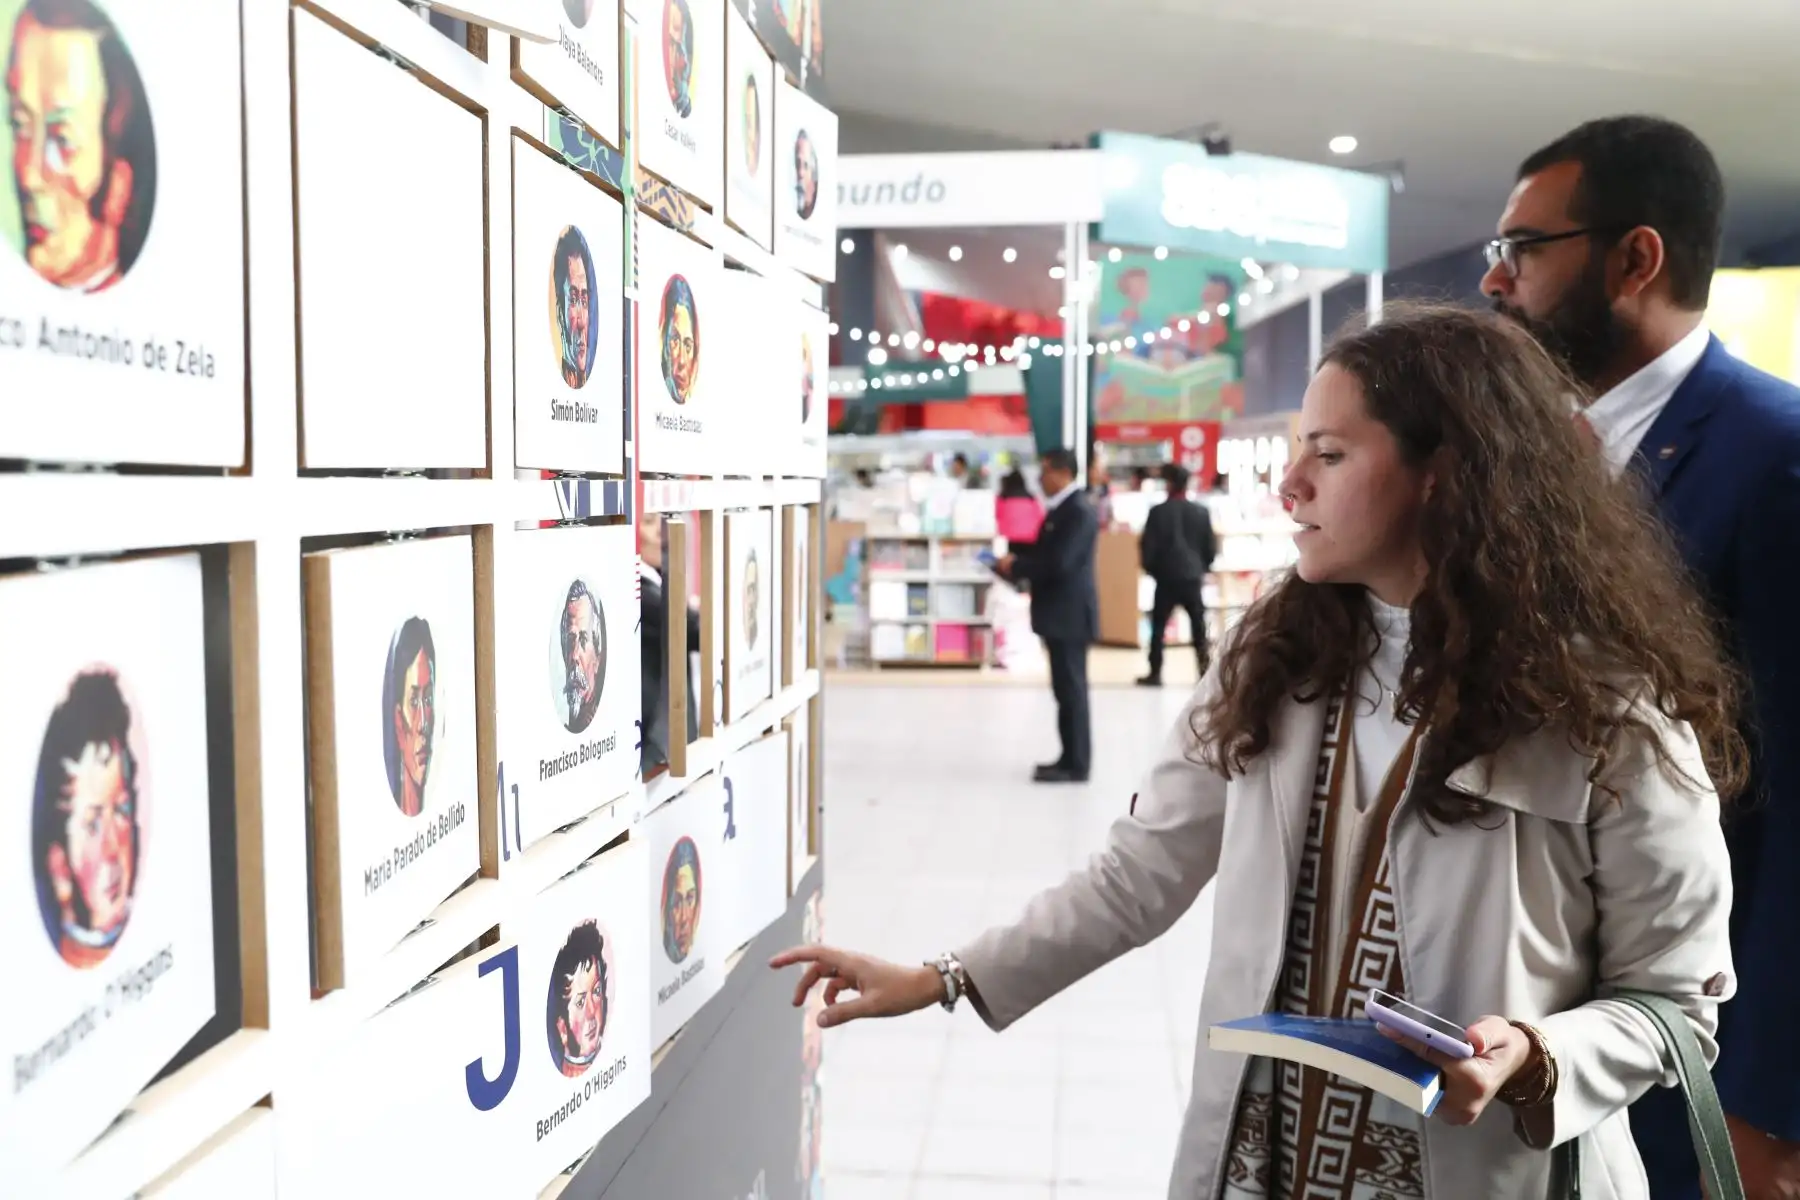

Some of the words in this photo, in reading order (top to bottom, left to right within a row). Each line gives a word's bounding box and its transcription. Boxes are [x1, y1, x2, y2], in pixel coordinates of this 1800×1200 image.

[143, 334, 167, 371] de
[176, 340, 215, 378] Zela
[551, 398, 574, 422] Simón
[539, 750, 578, 781] Francisco
[579, 730, 616, 764] Bolognesi
[393, 831, 425, 874] Parado
[426, 821, 437, 849] de
[438, 801, 465, 840] Bellido
[536, 1091, 582, 1143] Bernardo
[584, 1055, 627, 1101] O'Higgins
